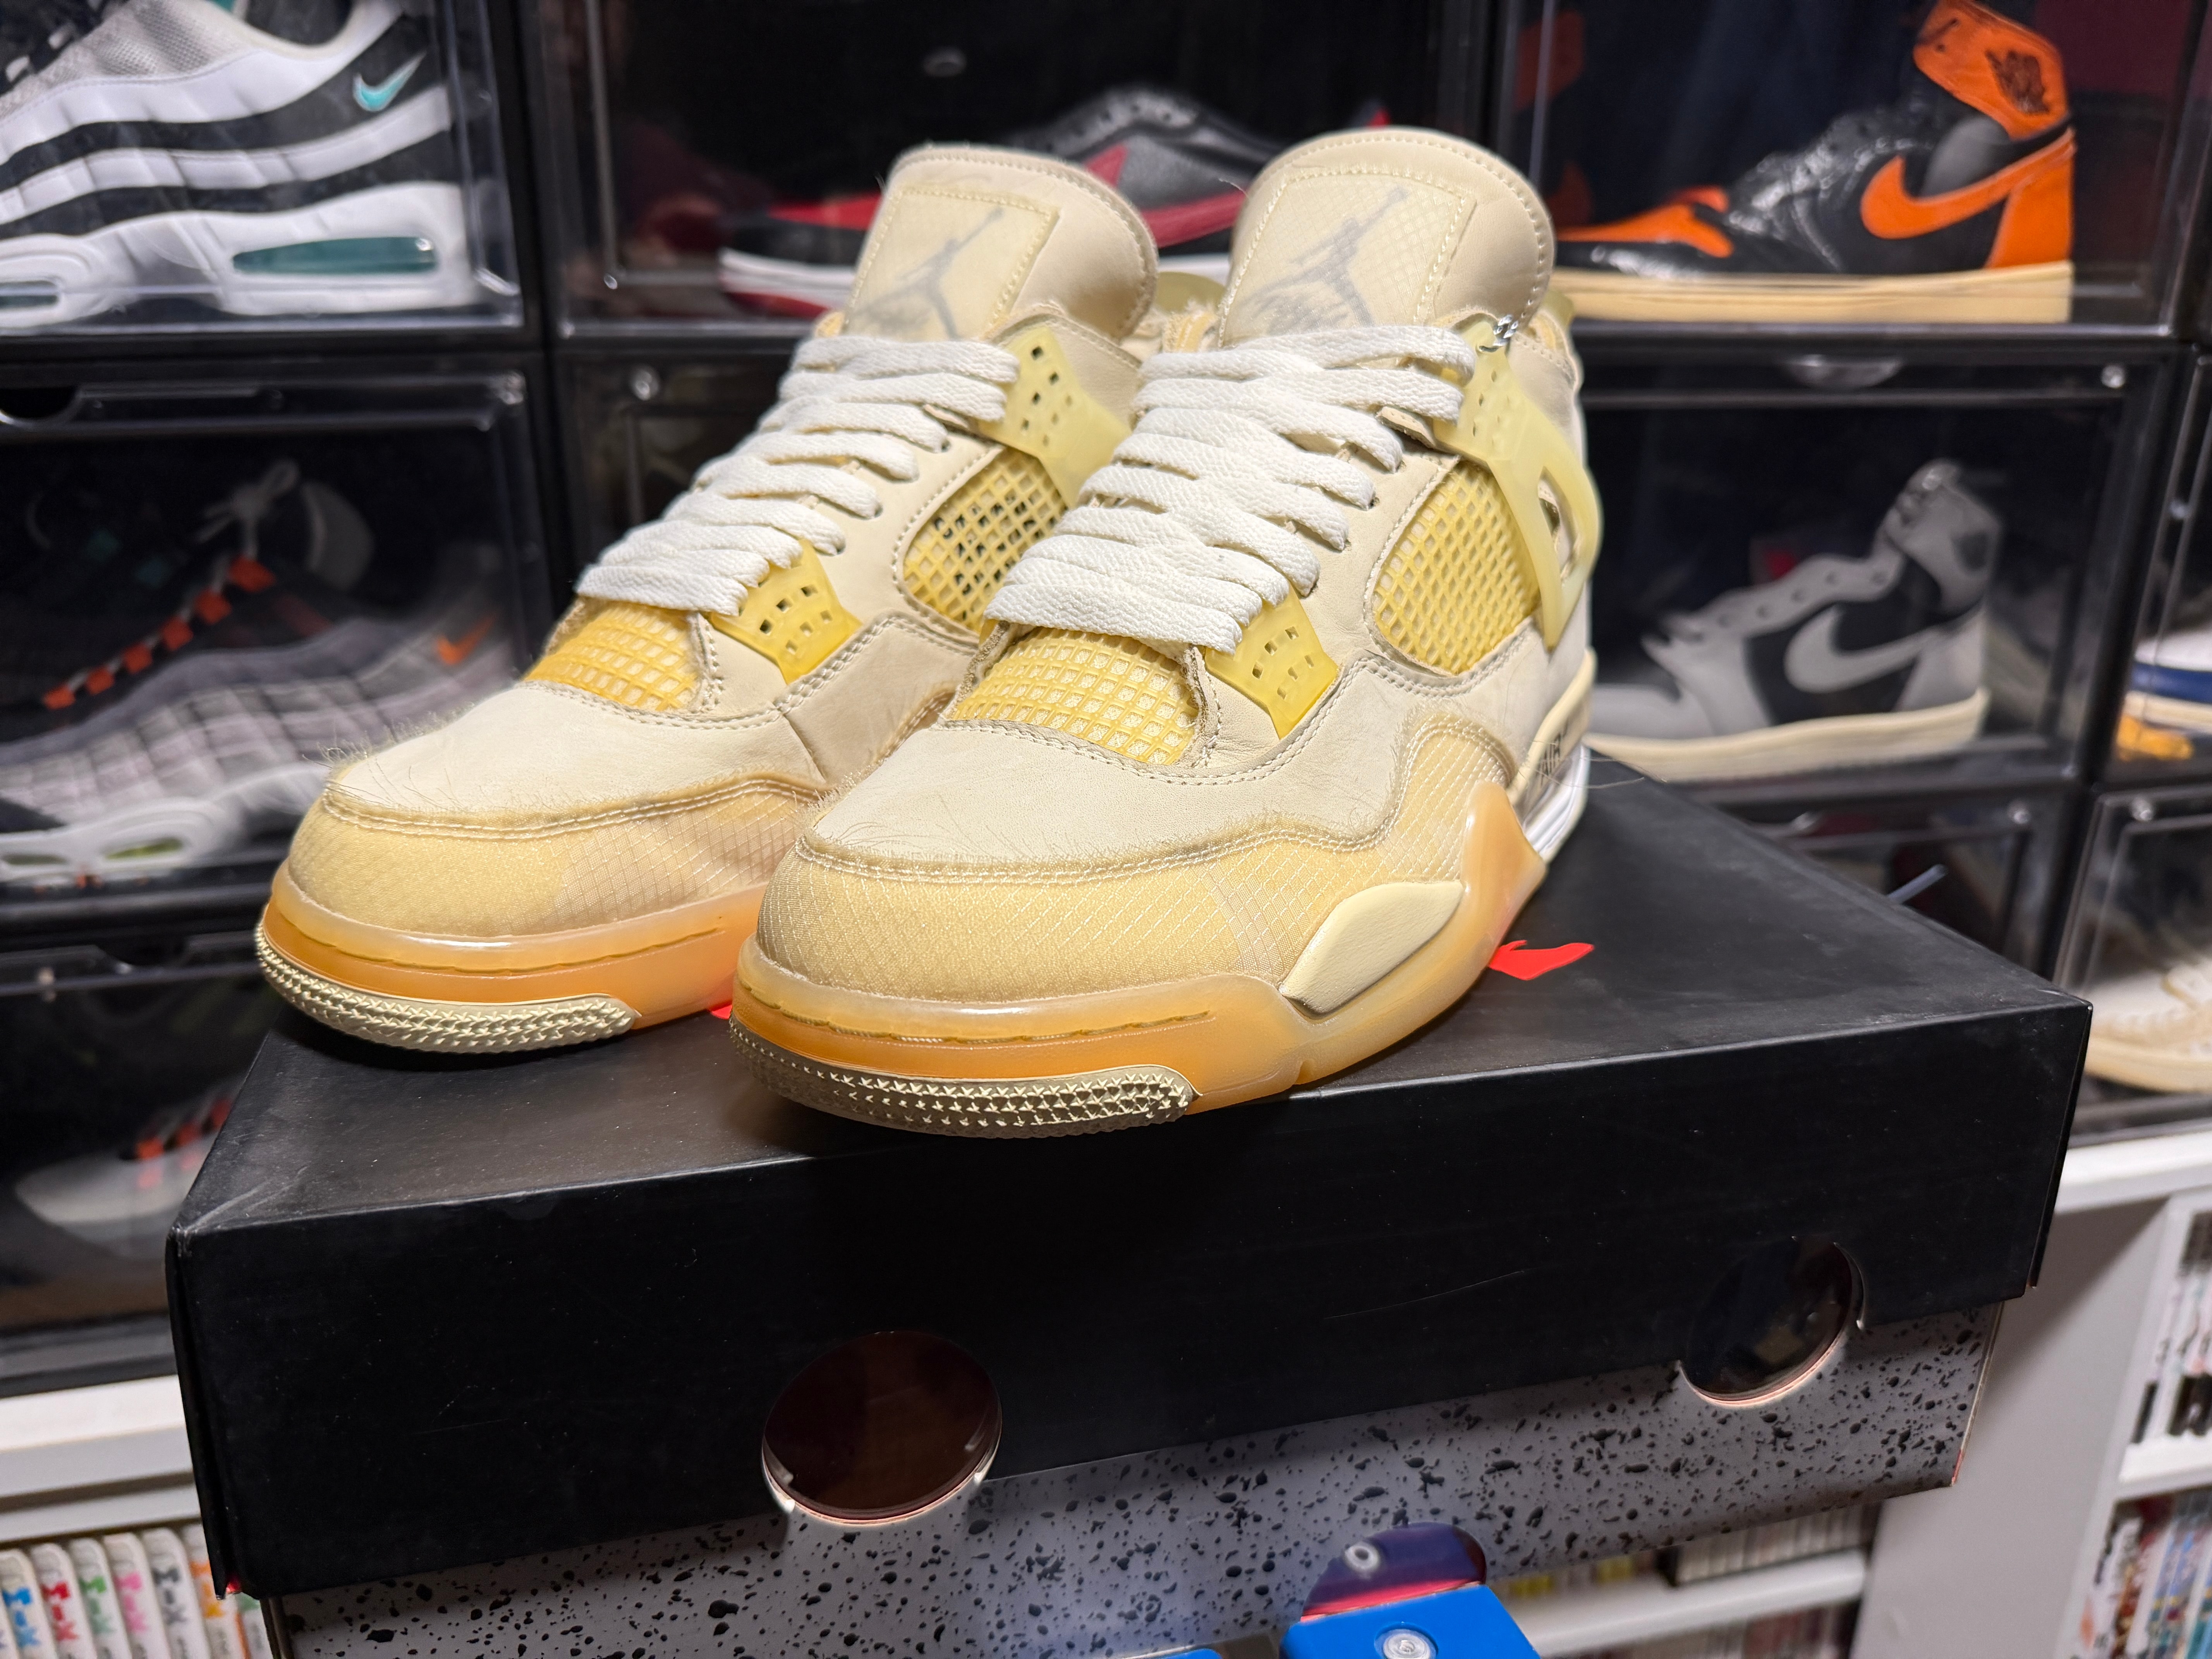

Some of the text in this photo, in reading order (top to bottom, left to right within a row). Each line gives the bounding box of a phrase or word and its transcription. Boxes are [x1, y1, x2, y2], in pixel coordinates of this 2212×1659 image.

[2, 1587, 41, 1649] MIX
[40, 1581, 79, 1642] MIX
[151, 1565, 189, 1625] MIX
